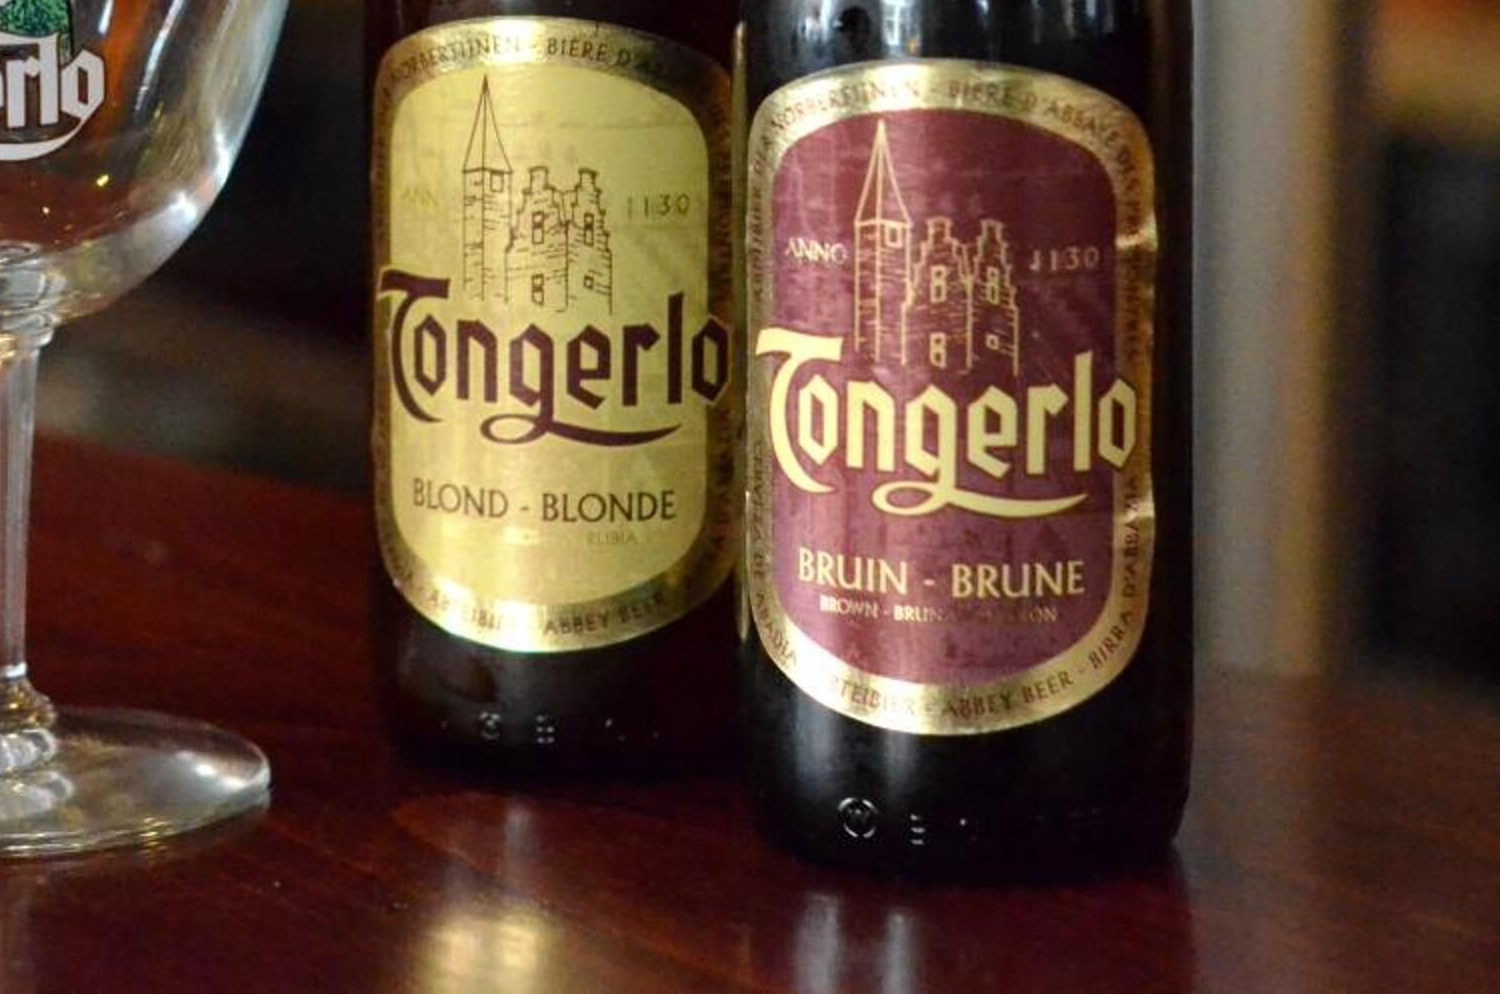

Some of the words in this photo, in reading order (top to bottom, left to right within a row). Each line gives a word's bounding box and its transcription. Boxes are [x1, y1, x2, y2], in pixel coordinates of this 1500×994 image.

[785, 237, 849, 265] ANNO
[380, 268, 731, 447] Tongerlo
[755, 326, 1137, 519] Tongerlo
[412, 476, 509, 517] BLOND
[540, 489, 677, 524] BLONDE
[799, 546, 909, 597] BRUIN
[951, 559, 1087, 599] BRUNE
[942, 690, 1012, 719] ABBEY
[1021, 669, 1074, 705] BEER
